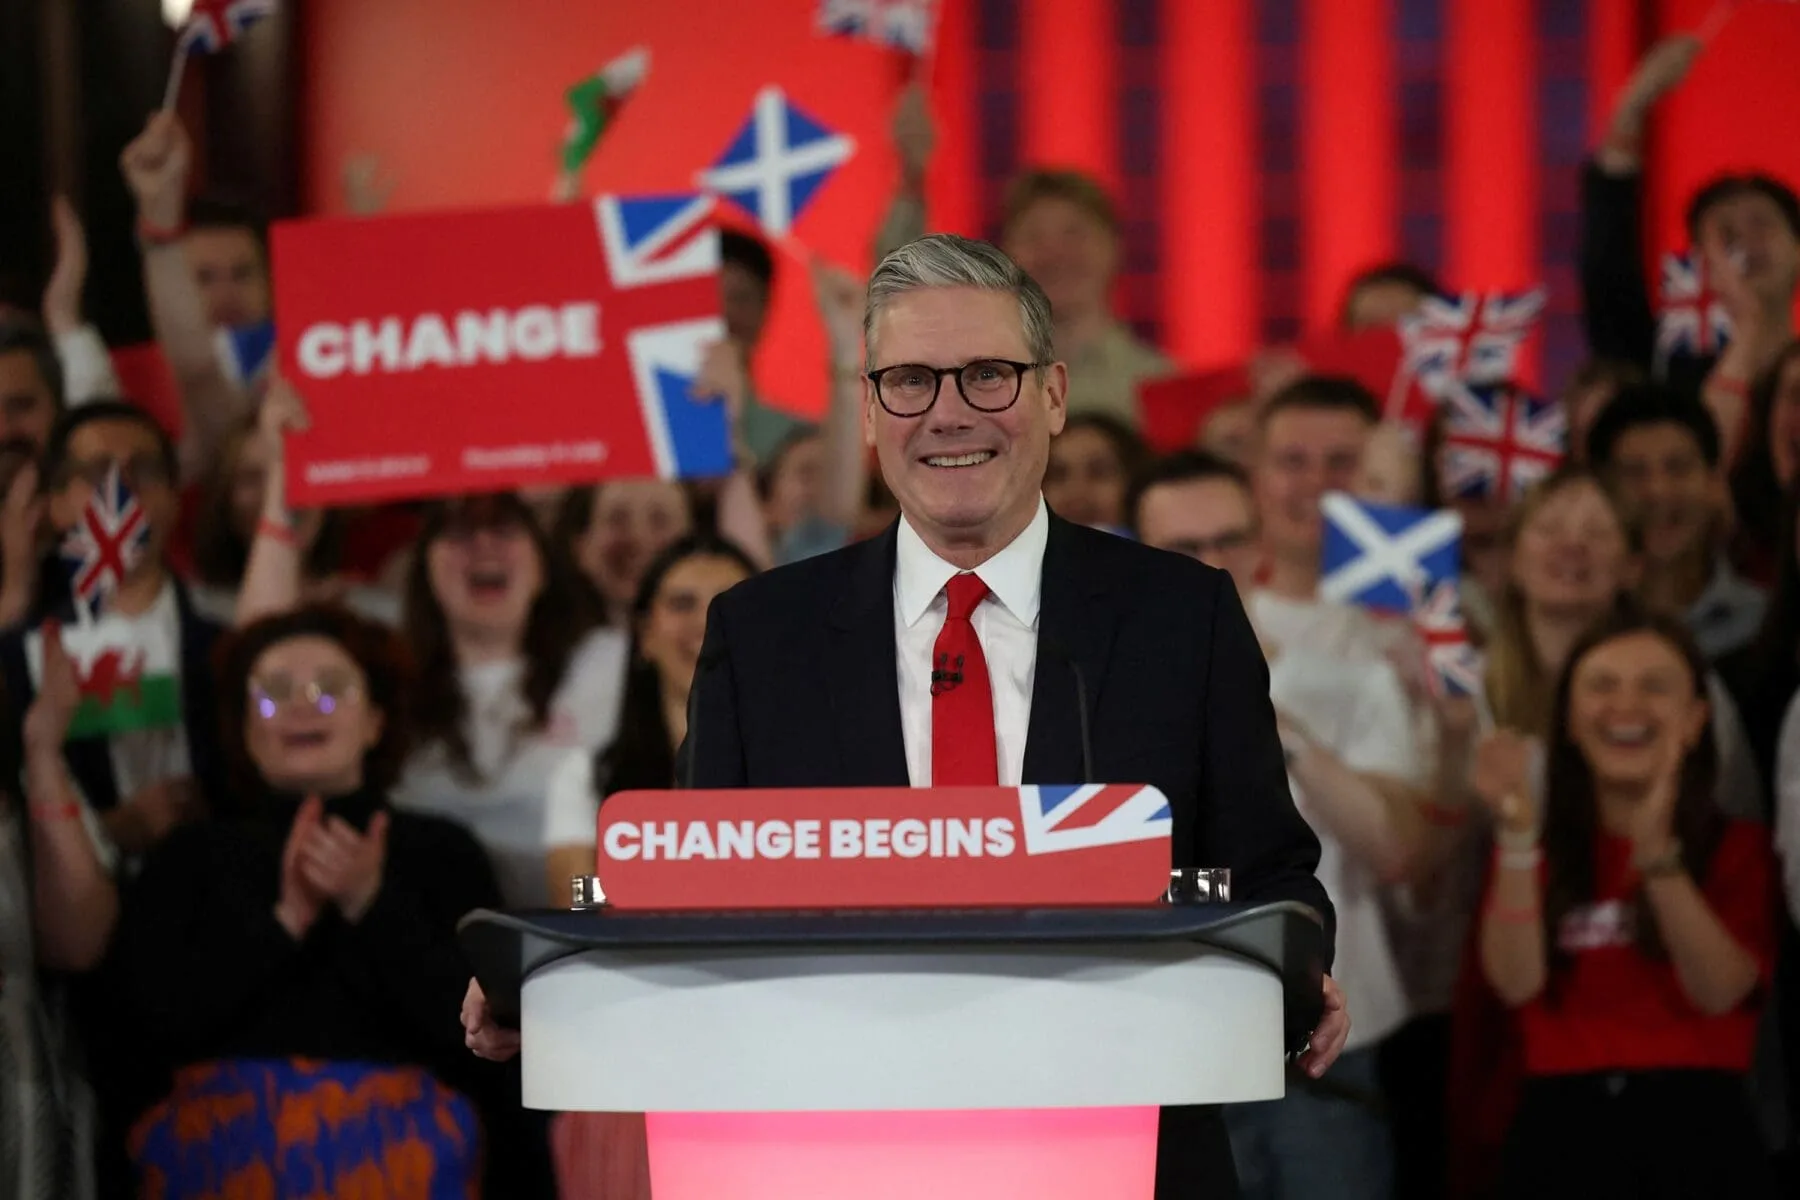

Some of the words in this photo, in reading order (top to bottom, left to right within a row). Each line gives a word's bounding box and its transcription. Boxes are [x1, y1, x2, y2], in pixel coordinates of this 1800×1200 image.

[299, 303, 600, 376] CHANGE
[604, 820, 820, 860] CHANGE
[830, 818, 1015, 858] BEGINS
